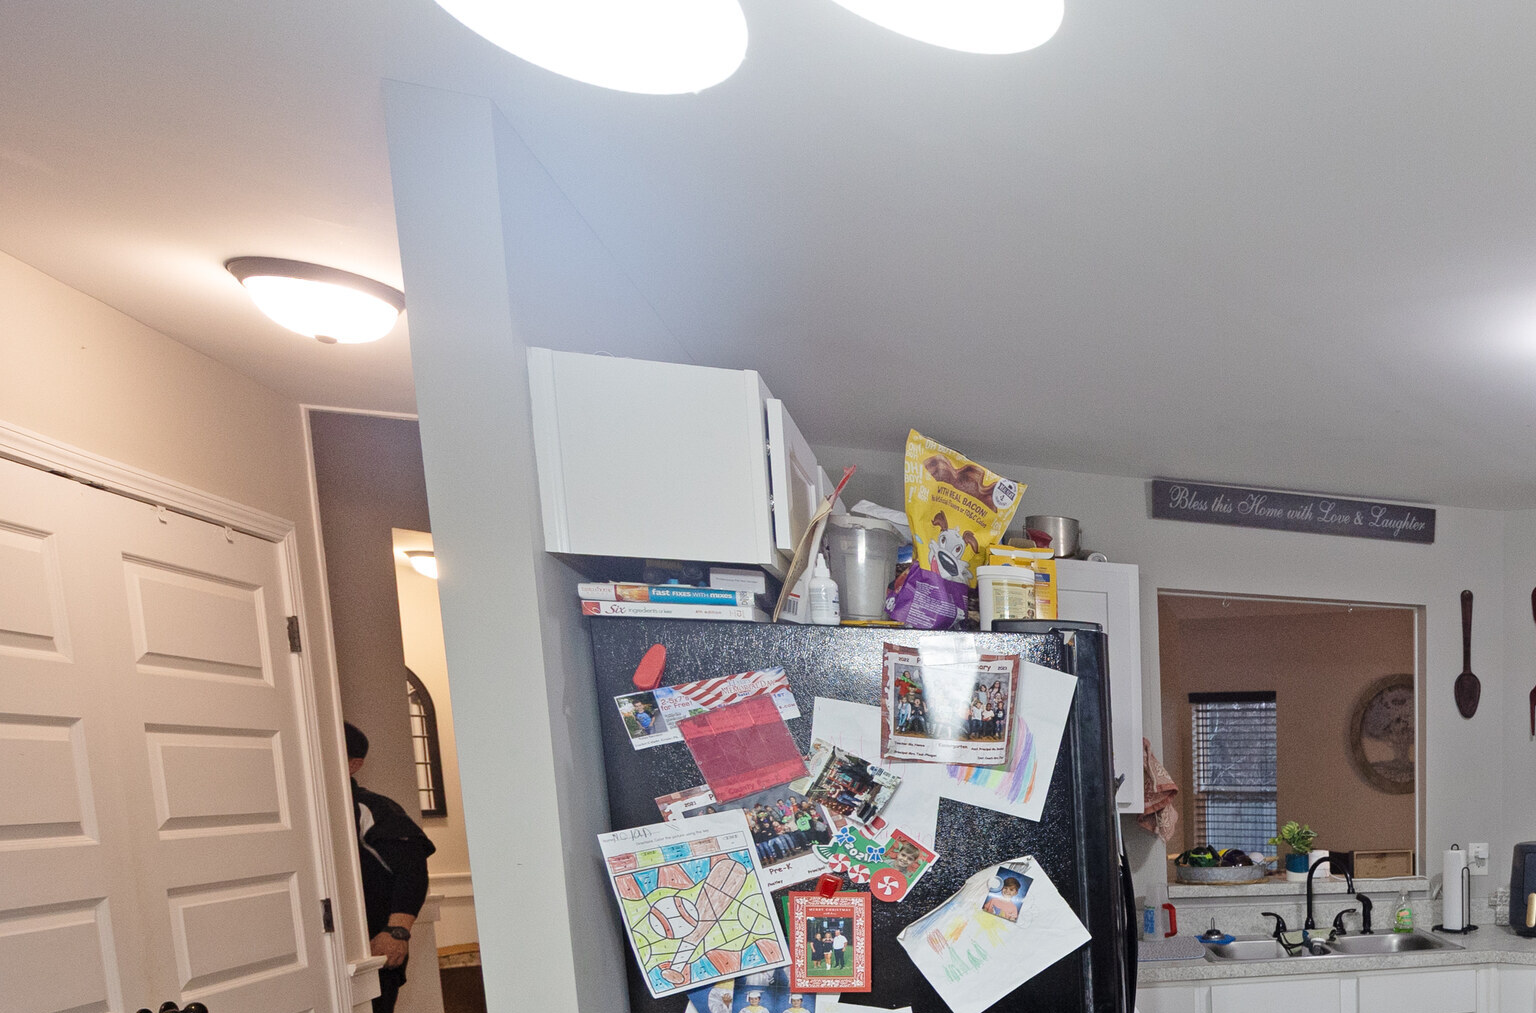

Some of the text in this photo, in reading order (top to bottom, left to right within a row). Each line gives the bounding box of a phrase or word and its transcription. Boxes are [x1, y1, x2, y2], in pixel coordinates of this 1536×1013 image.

[962, 497, 988, 518] BACON!
[1169, 485, 1426, 537] Bless this Home with Love & Laughter
[651, 588, 671, 596] fast
[605, 604, 627, 614] Six
[844, 843, 869, 863] 2021
[768, 863, 793, 875] Pre-K
